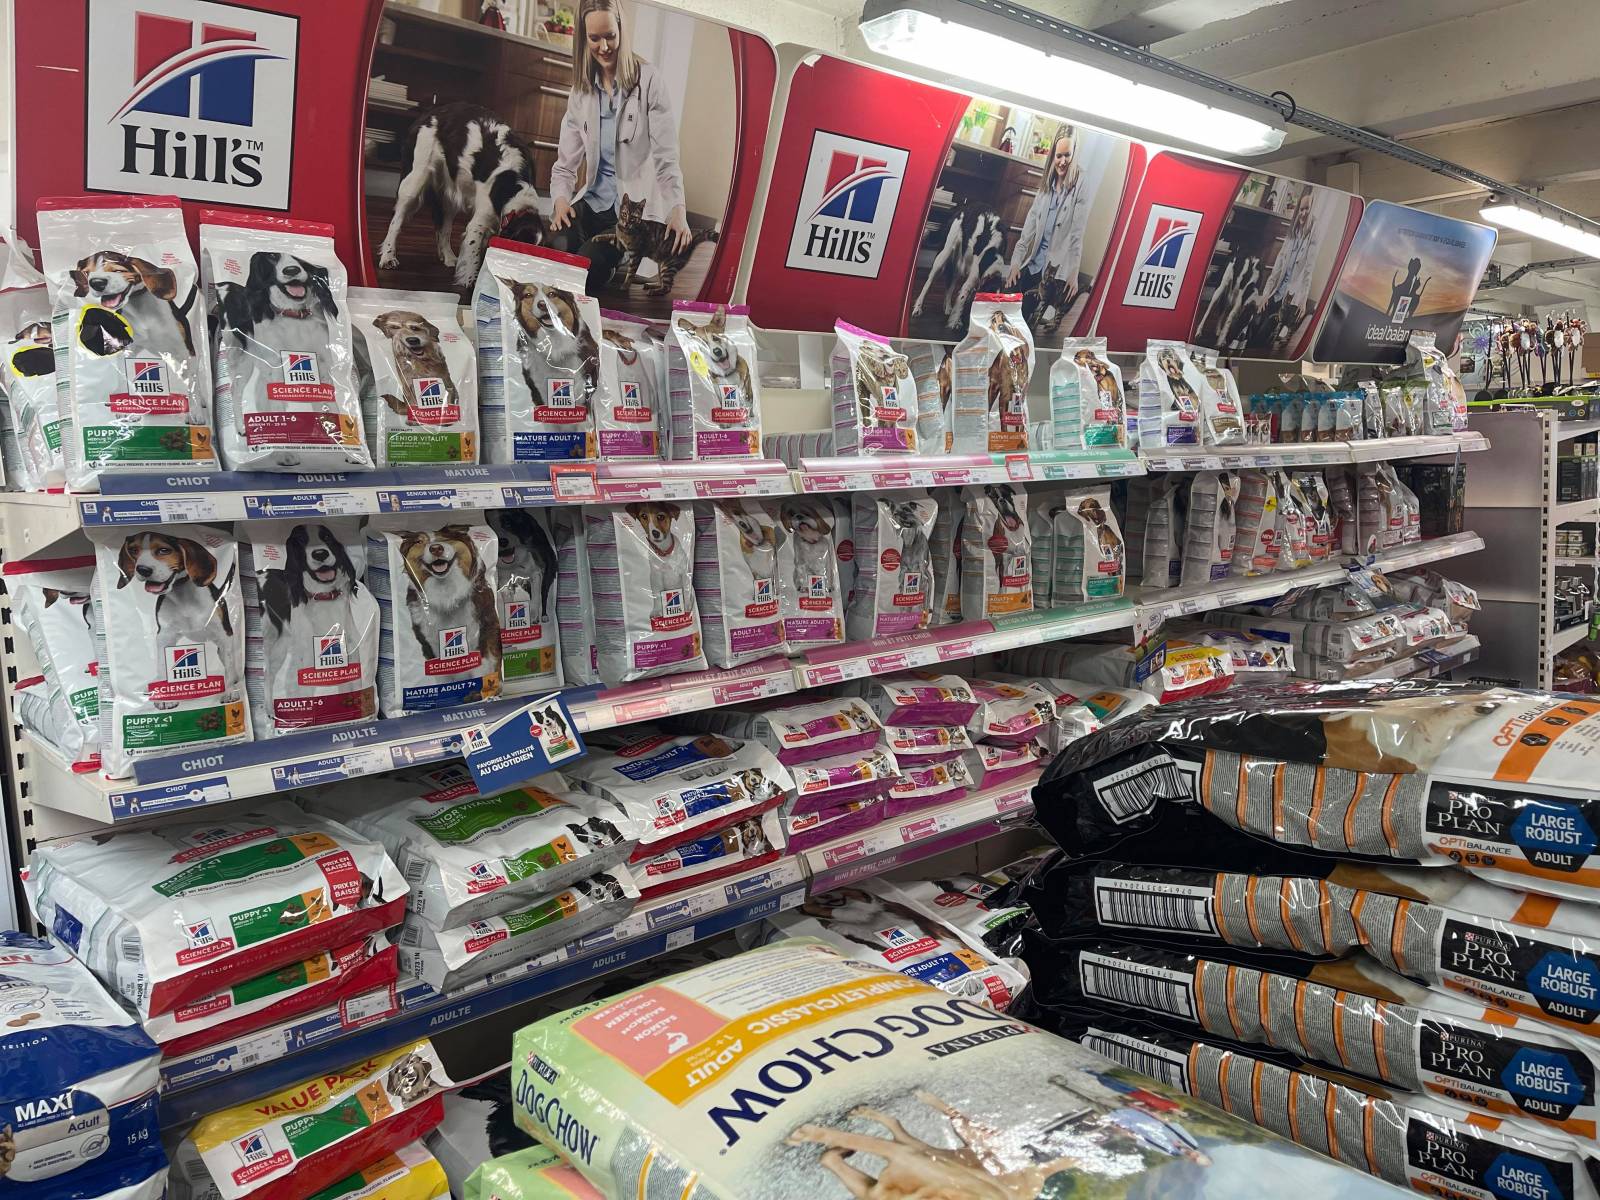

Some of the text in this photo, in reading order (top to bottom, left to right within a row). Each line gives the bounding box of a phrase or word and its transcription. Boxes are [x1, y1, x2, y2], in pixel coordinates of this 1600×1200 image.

[120, 124, 263, 187] Hill's
[804, 224, 872, 264] Hill's
[1134, 272, 1174, 299] Hill's
[1366, 324, 1410, 341] ideal balan
[290, 372, 315, 381] Hill's
[134, 382, 164, 392] Hill's
[297, 473, 346, 484] ADULTE
[445, 468, 490, 477] MATURE
[167, 476, 210, 486] CHIOT
[509, 619, 527, 627] Hill's
[655, 618, 679, 626] SCIENCE
[445, 646, 465, 657] Hill's
[320, 656, 344, 666] Hill's
[429, 657, 479, 669] SCIENCE PLAN
[173, 668, 201, 679] Hill's
[302, 671, 338, 679] SCIENCE
[718, 665, 764, 679] PETIT CHIEN
[154, 681, 221, 694] SCIENCE PLAN
[406, 688, 438, 696] MATURE
[441, 683, 466, 692] ADULT
[127, 717, 159, 725] PUPPY
[442, 708, 486, 722] MATURE
[332, 727, 378, 743] ADULTE
[472, 740, 487, 748] Hill's
[182, 755, 224, 770] CHIOT
[317, 757, 341, 766] ADULTE
[477, 757, 502, 769] FAVORISE
[511, 744, 535, 756] VITALITÉ
[480, 752, 533, 776] AU QUOTIDIEN
[165, 785, 187, 793] CHIOT
[461, 797, 503, 812] VITALITY
[1450, 800, 1492, 819] PRO
[1437, 812, 1501, 835] PLAN
[1531, 813, 1575, 830] LARGE
[1526, 826, 1582, 845] ROBUST
[322, 860, 339, 868] PRIX
[325, 862, 352, 872] BAISSE
[1535, 852, 1573, 866] ADULT
[835, 856, 896, 881] MINI PETIT CHIEN
[333, 882, 348, 891] PRIX
[335, 887, 360, 897] BAISSE
[232, 910, 260, 922] PUPPY
[749, 900, 777, 916] ADULTE
[468, 932, 505, 949] SCIENCE PLAN
[1474, 934, 1510, 950] PURINA
[180, 941, 231, 961] SCIENCE PLAN
[888, 940, 934, 959] SCIENCE PLAN
[1465, 942, 1509, 965] PRO
[592, 952, 626, 968] ADULTE
[918, 959, 939, 972] ADULT
[1452, 952, 1516, 982] PLAN
[201, 964, 233, 977] MILLION
[1547, 964, 1591, 986] LARGE
[1541, 976, 1598, 1000] ROBUST
[178, 999, 228, 1017] SCIENCE PLAN
[430, 1006, 471, 1026] ADULTE
[1548, 1001, 1587, 1019] ADULT
[620, 1007, 666, 1035] SAUMON
[634, 1015, 678, 1042] SALMON
[930, 1026, 1021, 1054] PURINA
[1450, 1035, 1483, 1048] PURINA
[195, 1054, 215, 1065] CHIOT
[1441, 1042, 1483, 1064] PRO
[685, 1039, 743, 1088] ADULT
[1432, 1052, 1493, 1080] PLAN
[1521, 1061, 1564, 1081] LARGE
[255, 1060, 377, 1116] VALUE PACK
[1515, 1074, 1570, 1095] ROBUST
[15, 1091, 73, 1122] MAXI
[1524, 1098, 1562, 1115] ADULT
[68, 1115, 100, 1133] Adult
[285, 1116, 314, 1132] PUPPY
[128, 1128, 149, 1145] 15 kg
[1434, 1136, 1467, 1150] PURINA
[245, 1150, 268, 1163] Hill's
[1426, 1141, 1466, 1164] PRO
[236, 1153, 289, 1181] SCIENCE PLAN
[1418, 1150, 1475, 1180] PLAN
[1502, 1165, 1542, 1187] LARGE
[1497, 1176, 1549, 1200] ROBUST
